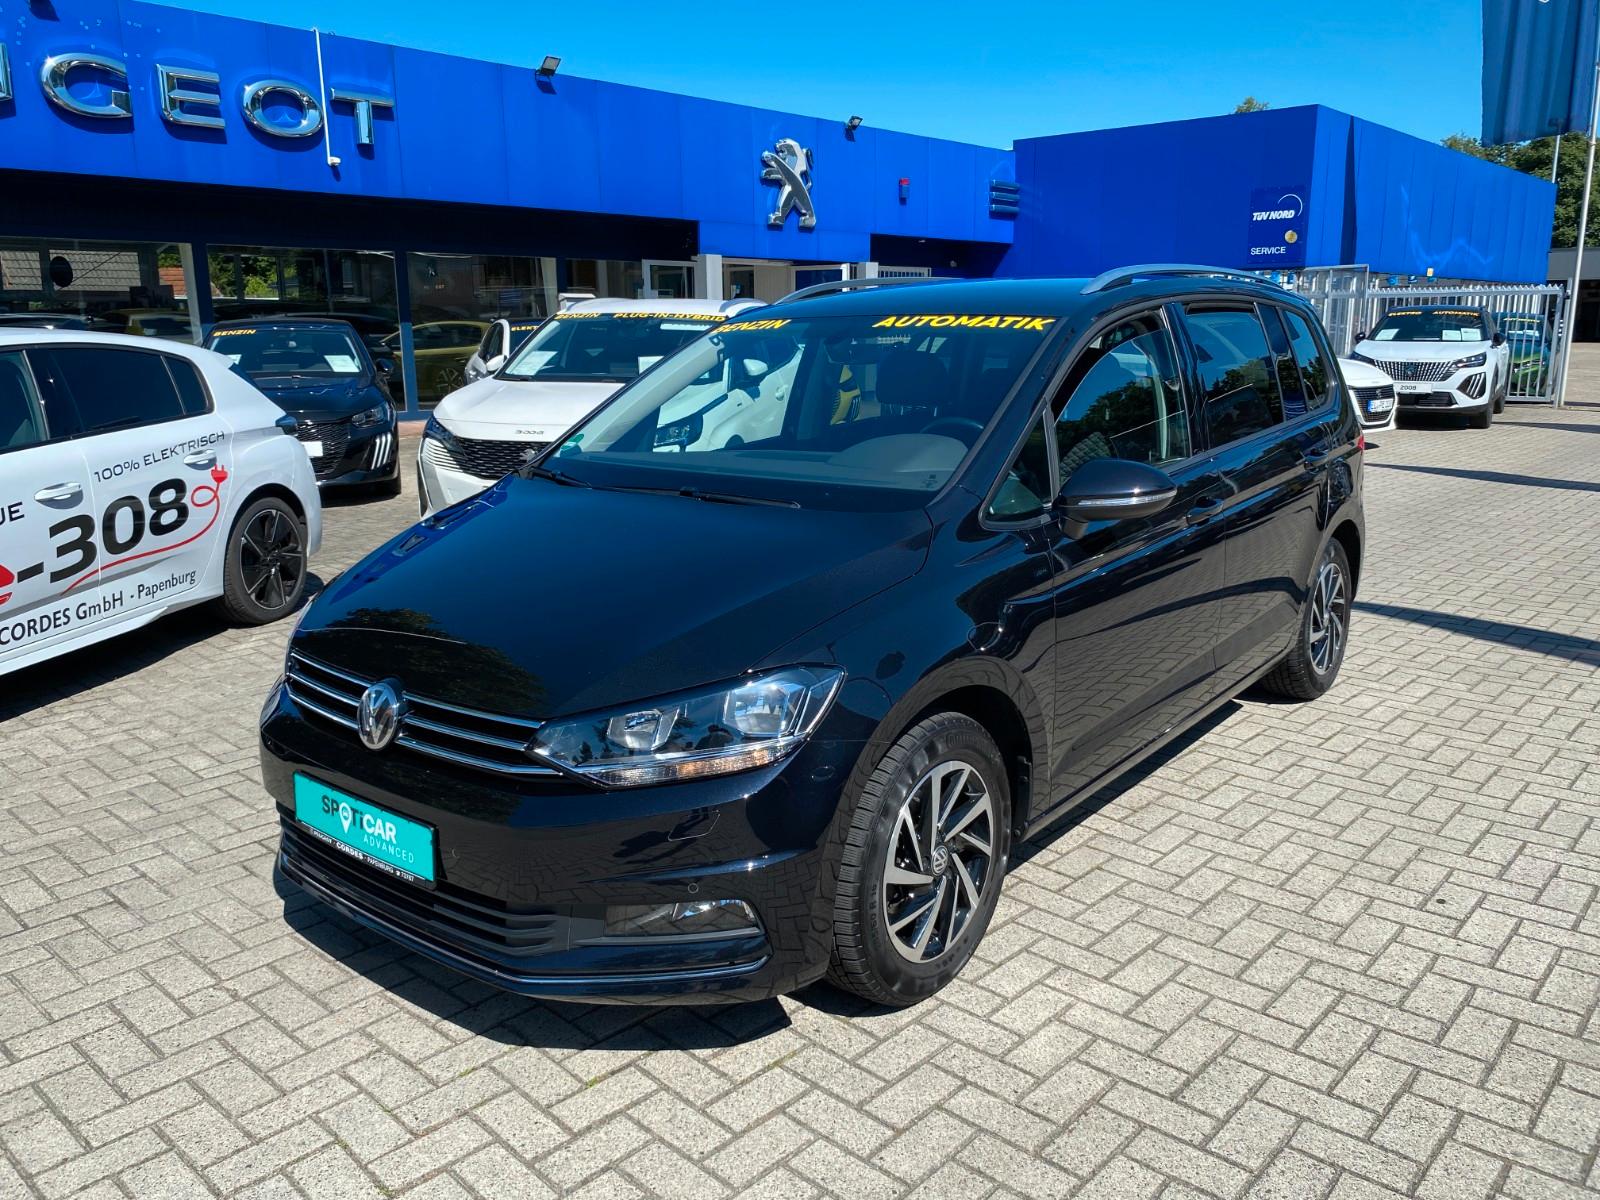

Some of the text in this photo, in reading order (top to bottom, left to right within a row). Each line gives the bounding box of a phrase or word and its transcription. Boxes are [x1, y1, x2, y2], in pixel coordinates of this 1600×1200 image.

[0, 43, 394, 145] GEOT
[1252, 210, 1295, 221] TÜV NORD
[1250, 246, 1286, 256] SERVICE
[554, 312, 726, 322] BENZIN PLUG-IN-HYBRID
[1432, 310, 1480, 318] AUTOMATIK
[212, 328, 257, 337] BENZIN
[711, 315, 1055, 334] BENZIN AUTOMATIK
[94, 431, 225, 483] 100% ELEKTRISCH
[0, 569, 197, 646] CORDES GmbH Papenburg
[336, 841, 364, 860] CORDES
[363, 834, 414, 864] ADVANCED
